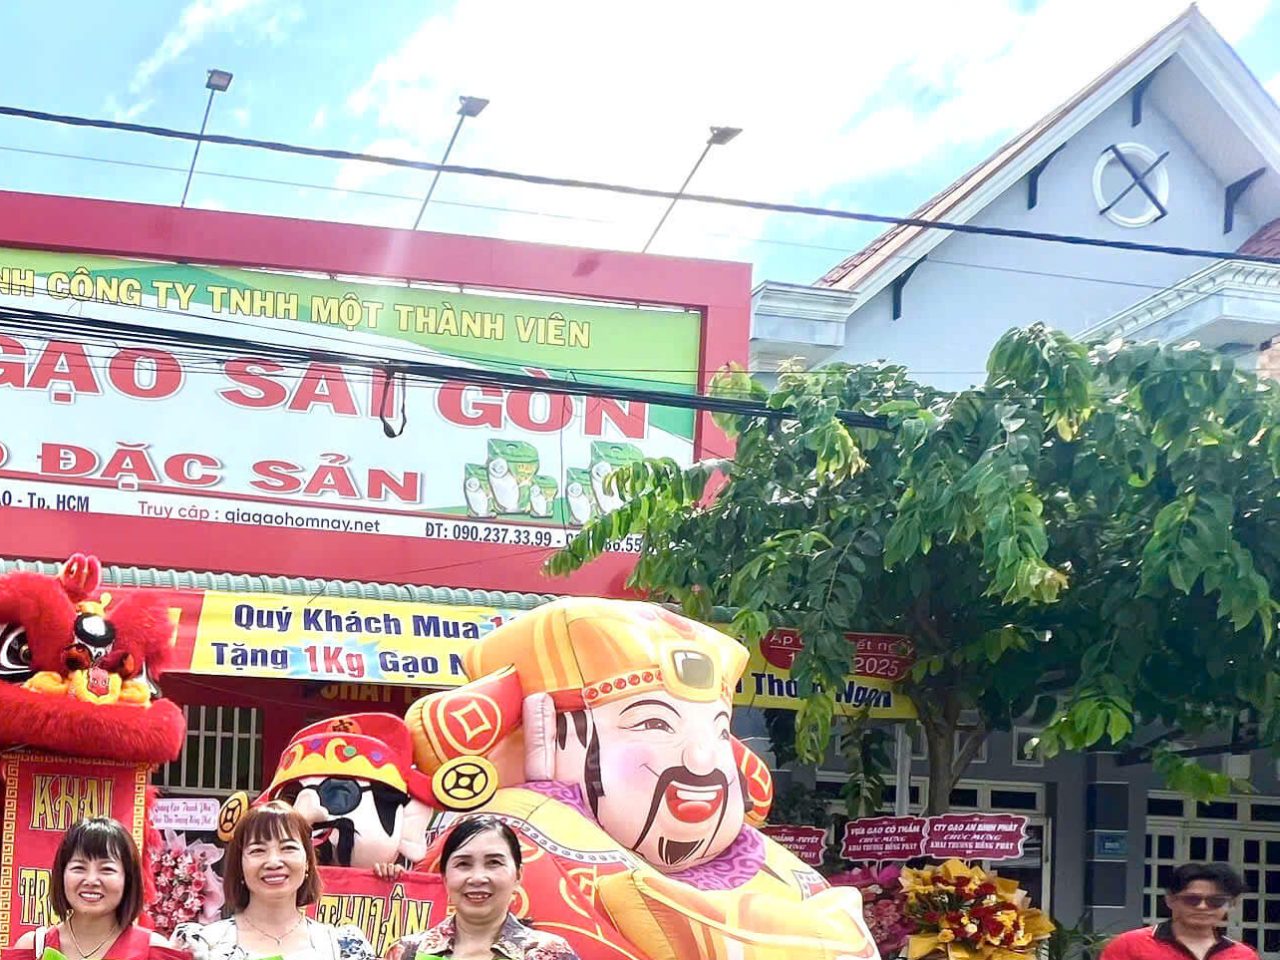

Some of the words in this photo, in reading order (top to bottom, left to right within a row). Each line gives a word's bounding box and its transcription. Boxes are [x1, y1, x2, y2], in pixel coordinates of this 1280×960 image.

[46, 266, 143, 307] CÔNG
[152, 279, 197, 310] TY
[207, 284, 299, 321] TNHH
[310, 292, 384, 332] MỘT
[395, 301, 505, 342] THÀNH
[516, 311, 592, 349] VIÊN
[436, 367, 648, 440] GÒN
[36, 440, 222, 490] ĐẶC
[251, 453, 423, 503] SẢN
[56, 493, 90, 512] HCM
[138, 500, 171, 520] Truy
[424, 522, 448, 539] ĐT:
[452, 523, 552, 547] 090.237.33.99
[234, 603, 292, 631] Quý
[303, 607, 401, 635] Khách
[412, 614, 480, 639] Mua
[211, 642, 288, 671] Tặng
[304, 645, 366, 679] 1Kg
[379, 650, 439, 678] Gạo
[29, 773, 114, 831] KHAI
